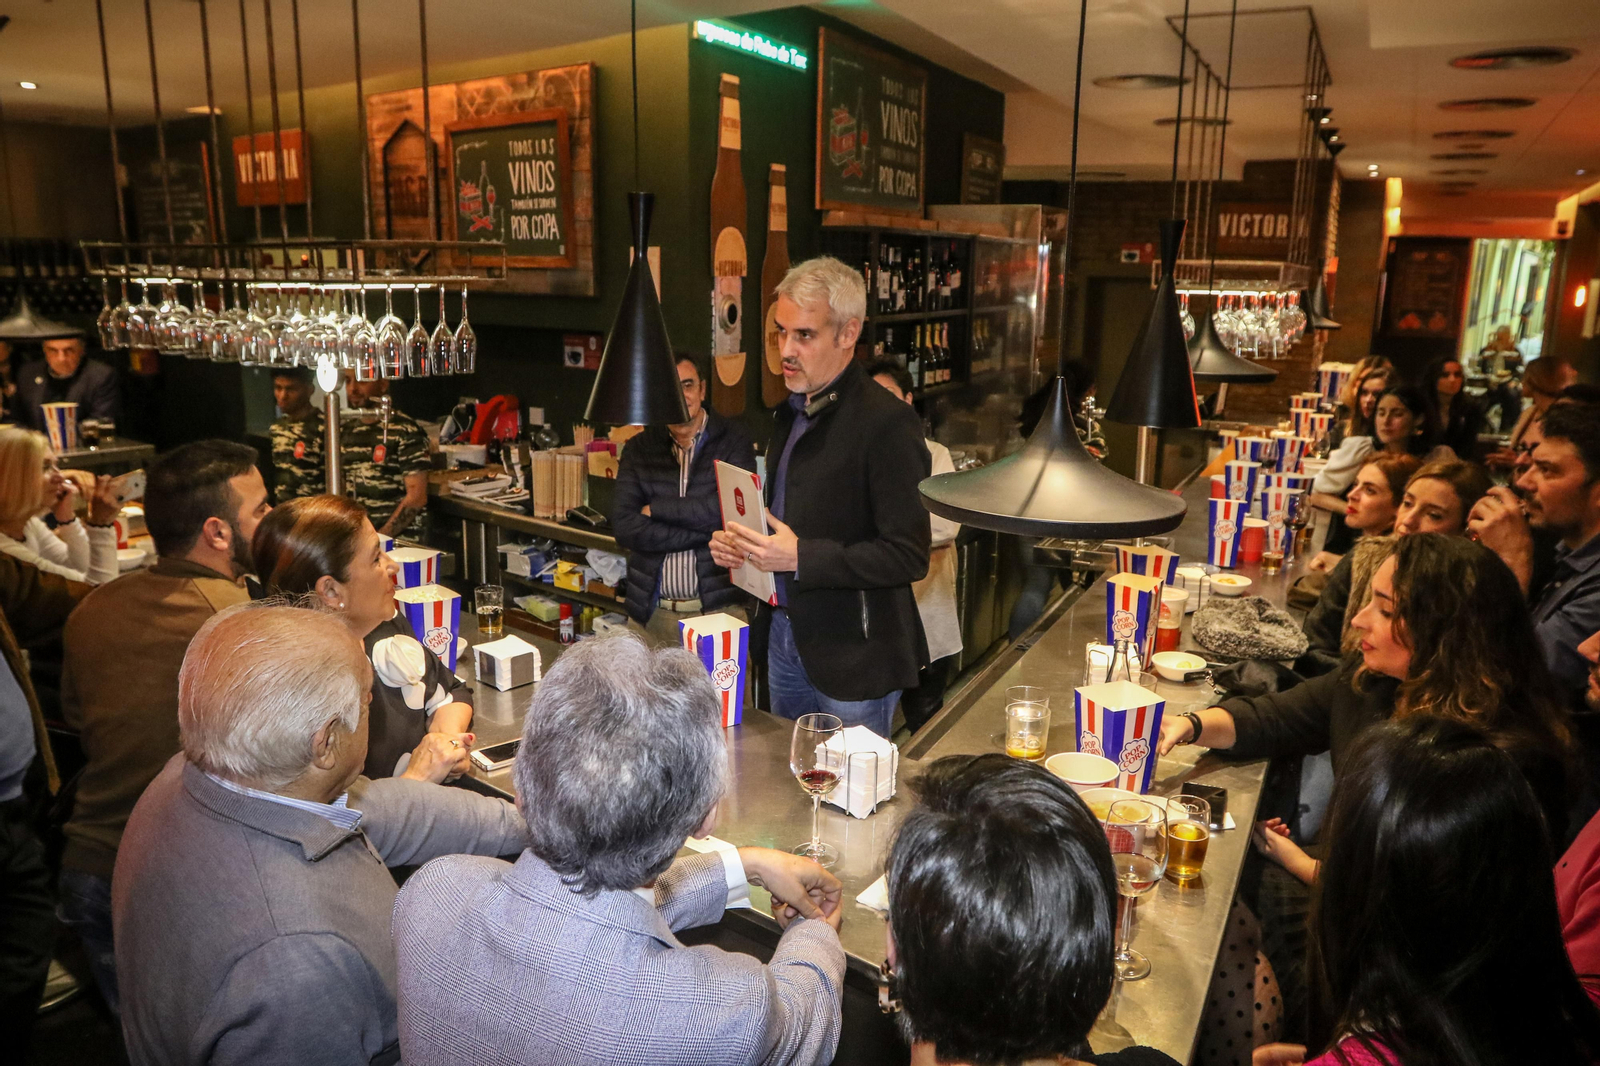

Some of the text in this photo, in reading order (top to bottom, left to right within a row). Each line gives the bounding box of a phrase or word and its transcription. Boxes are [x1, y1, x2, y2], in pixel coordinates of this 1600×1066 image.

[880, 100, 918, 148] VINOS
[509, 138, 555, 156] TODOS LOS
[238, 148, 299, 183] VITOIA
[508, 160, 555, 194] VINOS
[879, 165, 917, 198] POR COPA
[511, 213, 560, 240] POR COPA
[1219, 213, 1309, 238] VICTORA
[1116, 621, 1134, 630] CORN
[428, 632, 444, 644] POP
[716, 669, 735, 685] CORN
[717, 665, 731, 678] POP
[1085, 741, 1096, 749] POP
[1124, 744, 1142, 760] POP
[1123, 750, 1147, 768] CORN
